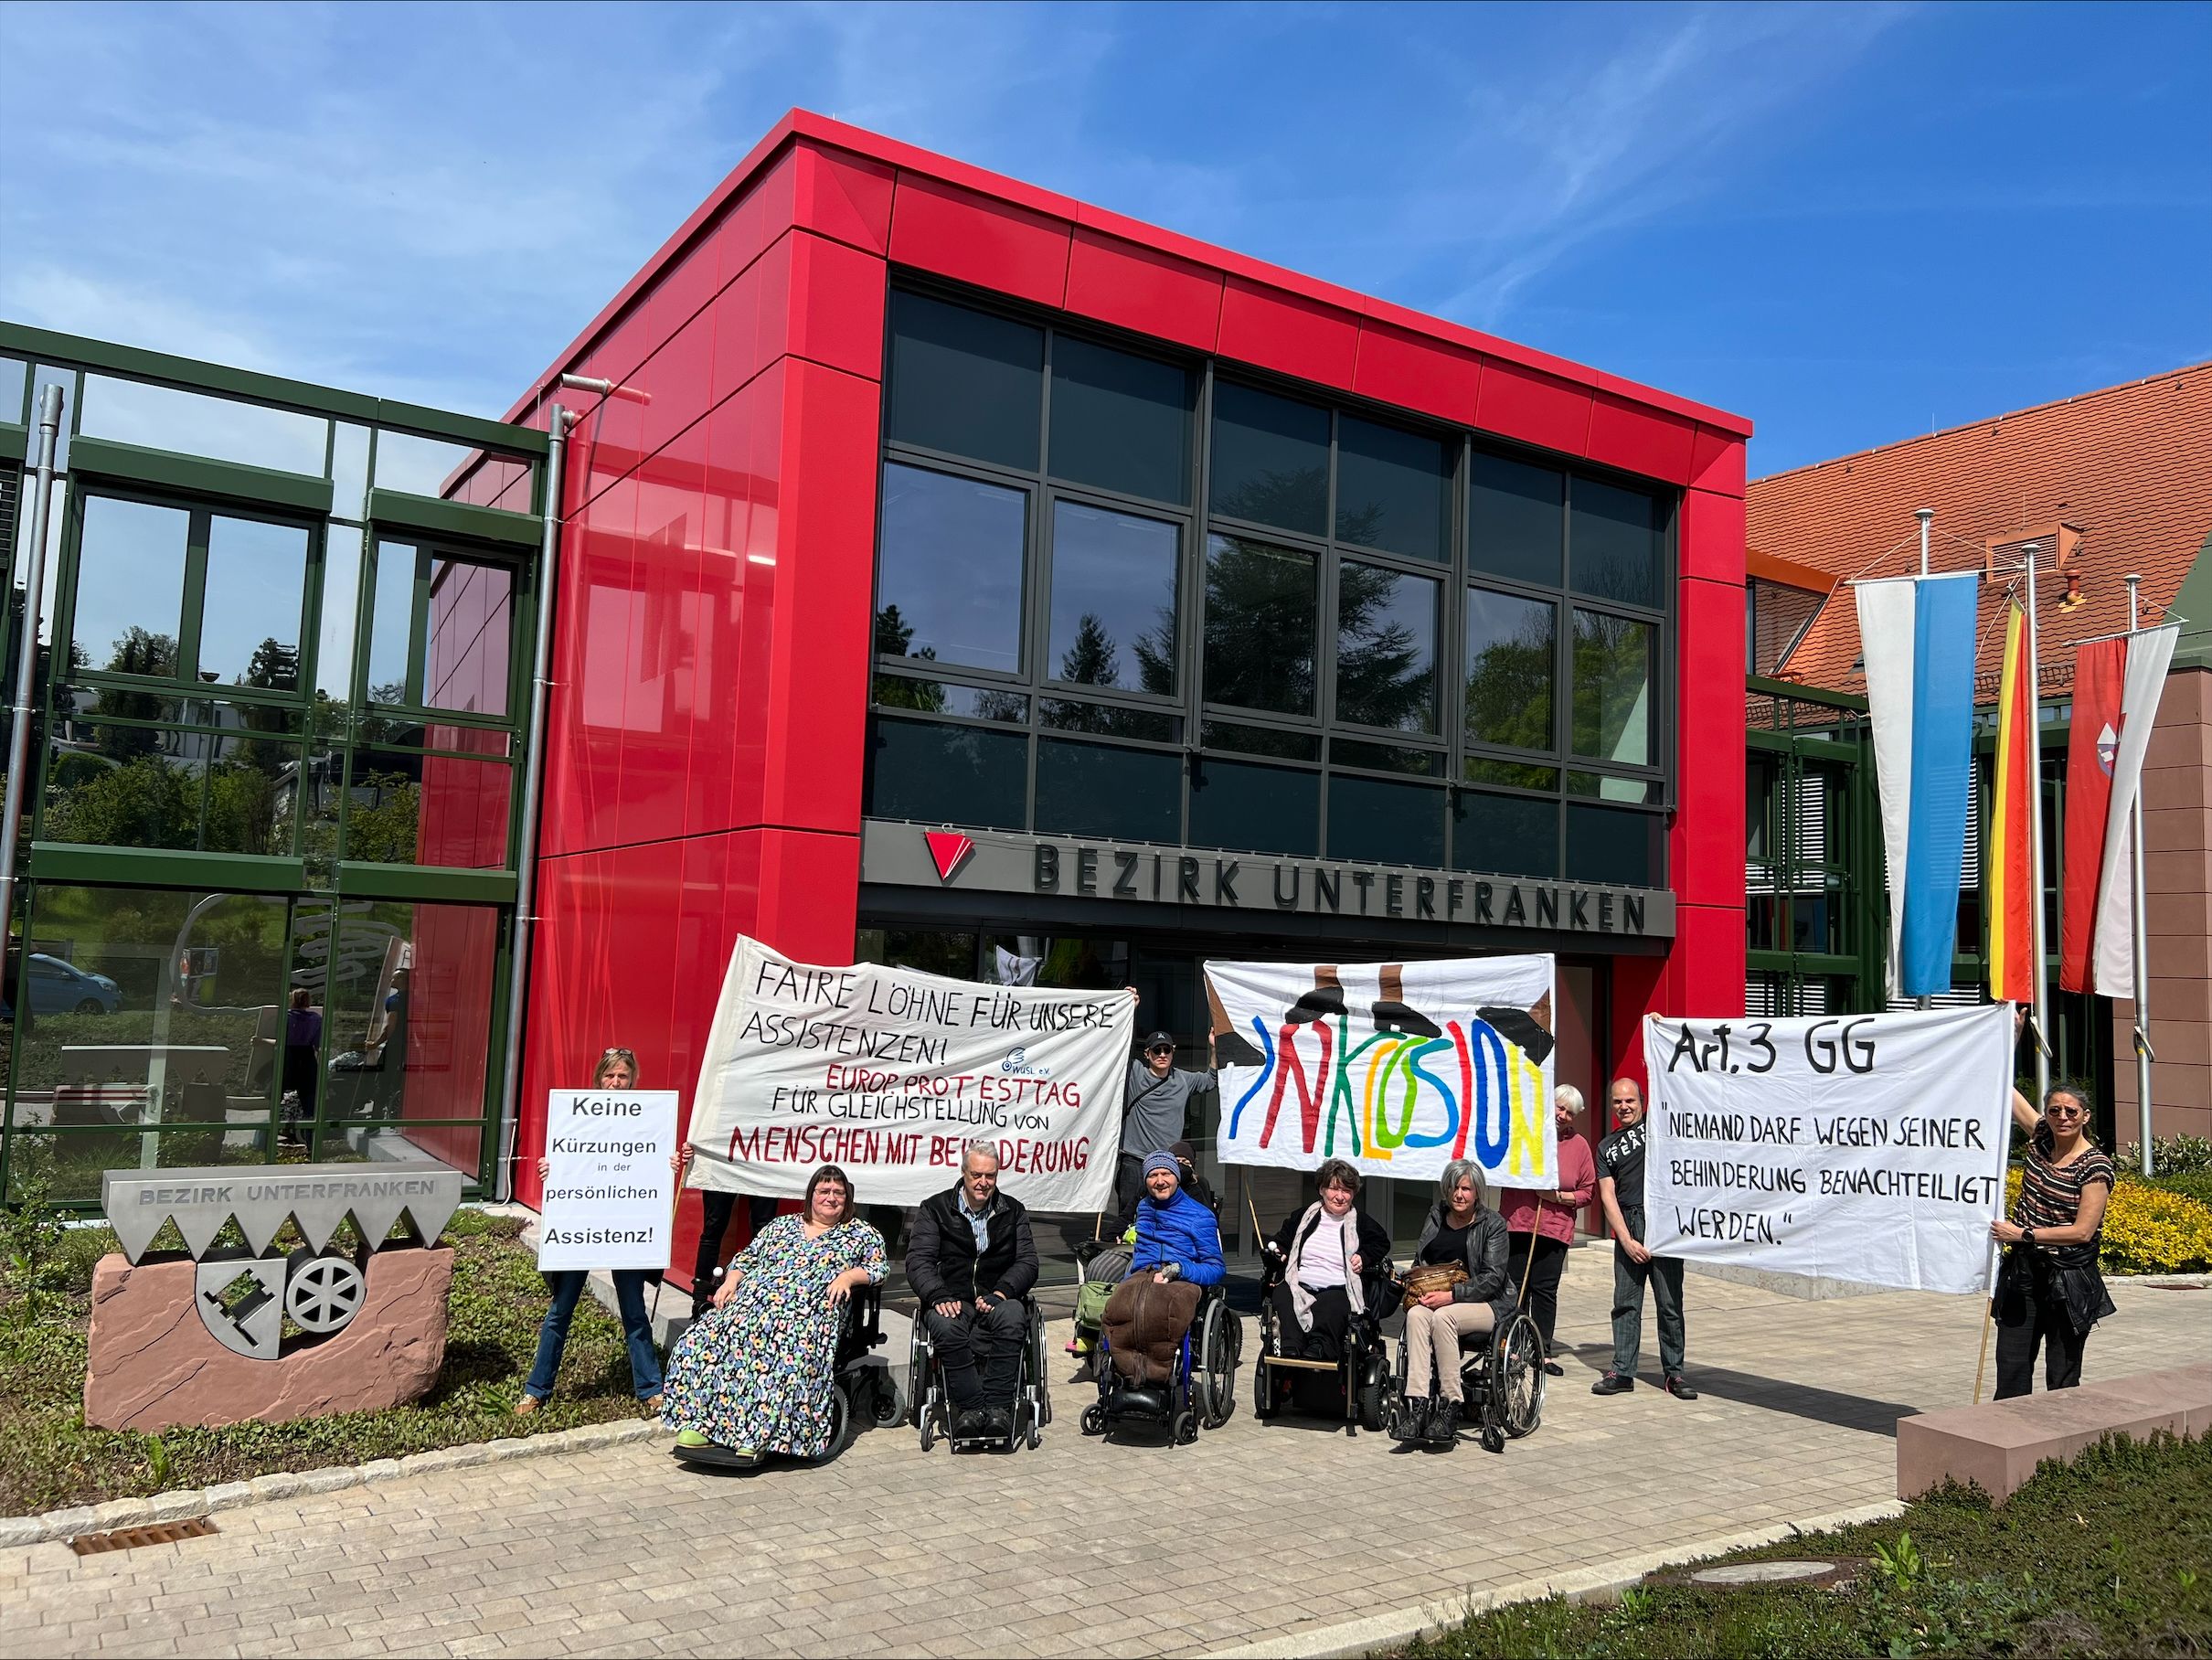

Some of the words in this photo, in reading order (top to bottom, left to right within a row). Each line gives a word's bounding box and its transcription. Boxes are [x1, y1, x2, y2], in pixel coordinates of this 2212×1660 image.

[1034, 844, 1239, 906] BEZIRK
[1273, 863, 1645, 933] UNTERFRANKEN
[756, 960, 856, 1009] FAIRE
[867, 979, 963, 1027] LÖHNE
[970, 991, 1022, 1030] FÜR
[1029, 1002, 1116, 1031] UNSERE
[739, 1010, 948, 1066] ASSISTENZEN!
[1804, 1017, 1875, 1074] GG
[826, 1063, 899, 1095] EUROP.
[572, 1097, 642, 1116] Keine
[771, 1085, 818, 1113] FÜR
[828, 1092, 1007, 1127] GLEICHSTELLUNG
[1014, 1113, 1049, 1130] VON
[552, 1138, 656, 1157] Kürzungen
[728, 1125, 879, 1165] MENSCHEN
[885, 1132, 923, 1165] MIT
[929, 1135, 1090, 1175] BEDERUNG
[1749, 1115, 1802, 1144] DARF
[1813, 1116, 1888, 1147] WEGEN
[1893, 1116, 1985, 1151] SEINER
[597, 1162, 608, 1172] in
[613, 1161, 631, 1172] der
[1670, 1159, 1806, 1194] BEHINDERUNG
[1819, 1166, 1998, 1205] BENACHTEILIGT
[138, 1186, 233, 1206] BEZIRK
[247, 1180, 436, 1201] UNTERFRANKEN
[546, 1186, 658, 1202] persönlichen
[544, 1227, 654, 1244] Assistenz!
